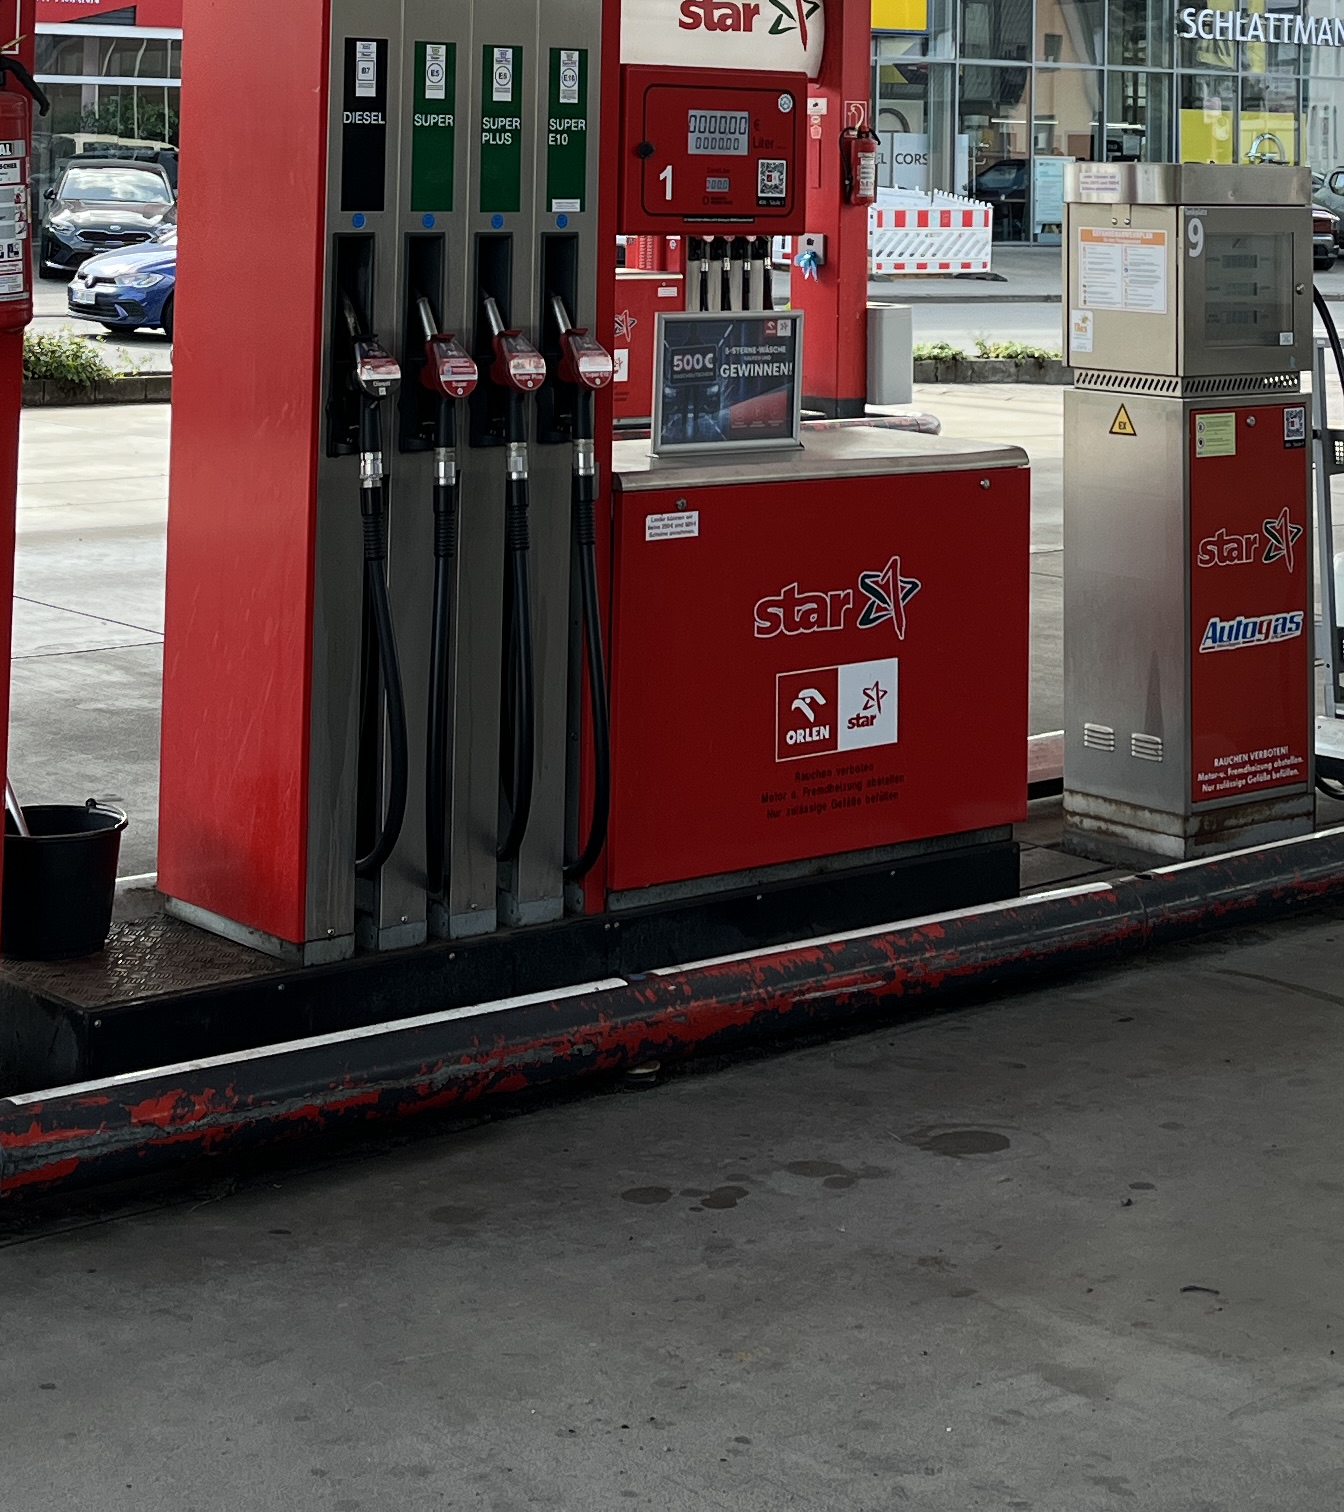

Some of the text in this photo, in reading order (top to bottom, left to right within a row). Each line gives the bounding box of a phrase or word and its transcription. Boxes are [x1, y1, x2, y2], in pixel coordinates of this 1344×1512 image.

[342, 111, 386, 124] DIESEL
[414, 114, 454, 127] SUPER
[482, 117, 521, 130] SUPER
[549, 119, 586, 131] SUPER
[481, 132, 512, 145] PLUS
[548, 134, 568, 145] E10
[659, 164, 673, 201] 1
[1187, 217, 1204, 258] 9
[720, 362, 793, 378] GEWINNEN!
[1118, 421, 1127, 431] EX
[1197, 528, 1260, 568] star
[754, 582, 853, 638] star
[1201, 611, 1304, 648] Autogas
[847, 712, 877, 730] star
[786, 724, 830, 745] ORLEN
[1214, 746, 1289, 767] RAUCHEN VERBOTEN!
